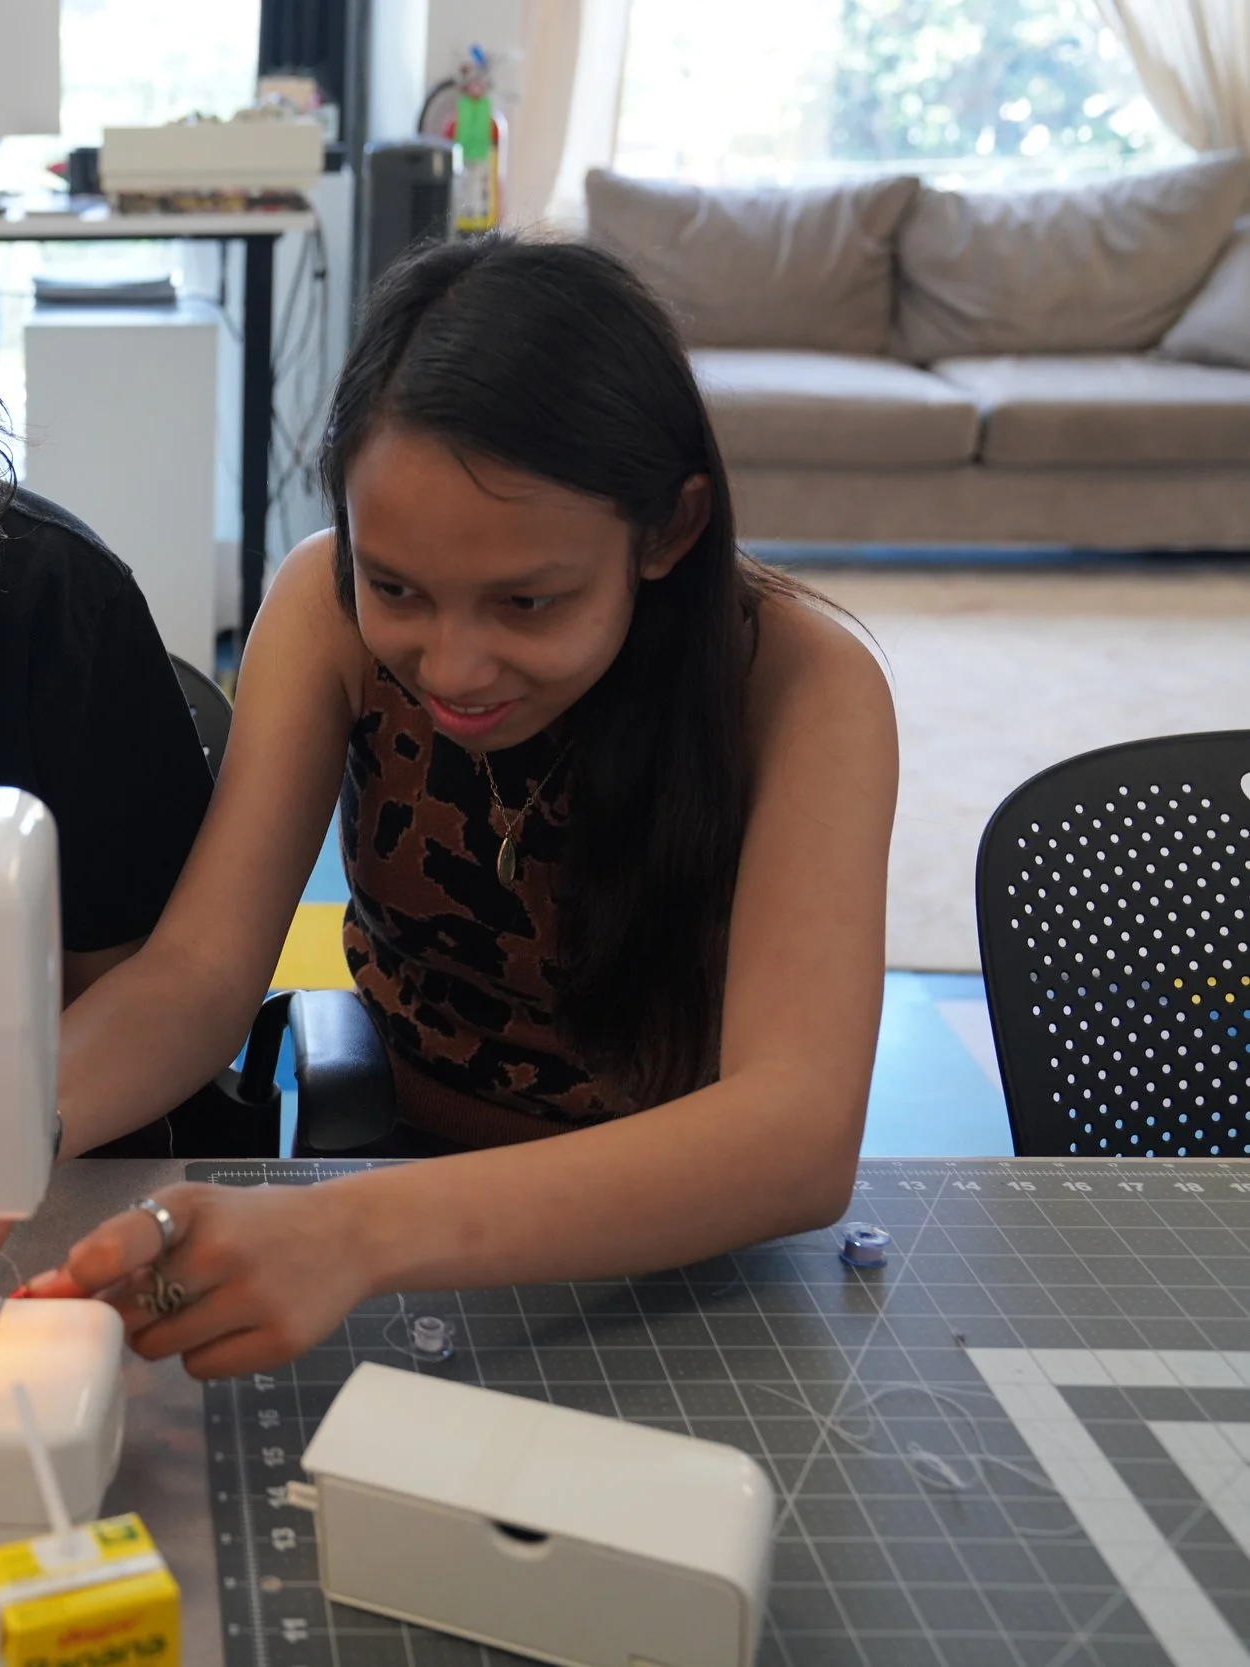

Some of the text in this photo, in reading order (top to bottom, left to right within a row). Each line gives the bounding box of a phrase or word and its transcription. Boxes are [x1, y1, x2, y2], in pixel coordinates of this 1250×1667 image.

[853, 1180, 874, 1191] 2
[897, 1180, 927, 1191] 13
[952, 1181, 982, 1191] 14
[1006, 1181, 1037, 1192] 15
[1061, 1182, 1093, 1192] 16
[1117, 1182, 1145, 1192] 17
[1173, 1182, 1205, 1193] 18
[253, 1373, 276, 1391] 17
[257, 1409, 281, 1429] 16
[261, 1446, 286, 1468] 15
[271, 1526, 297, 1552] 13
[280, 1617, 309, 1644] 11
